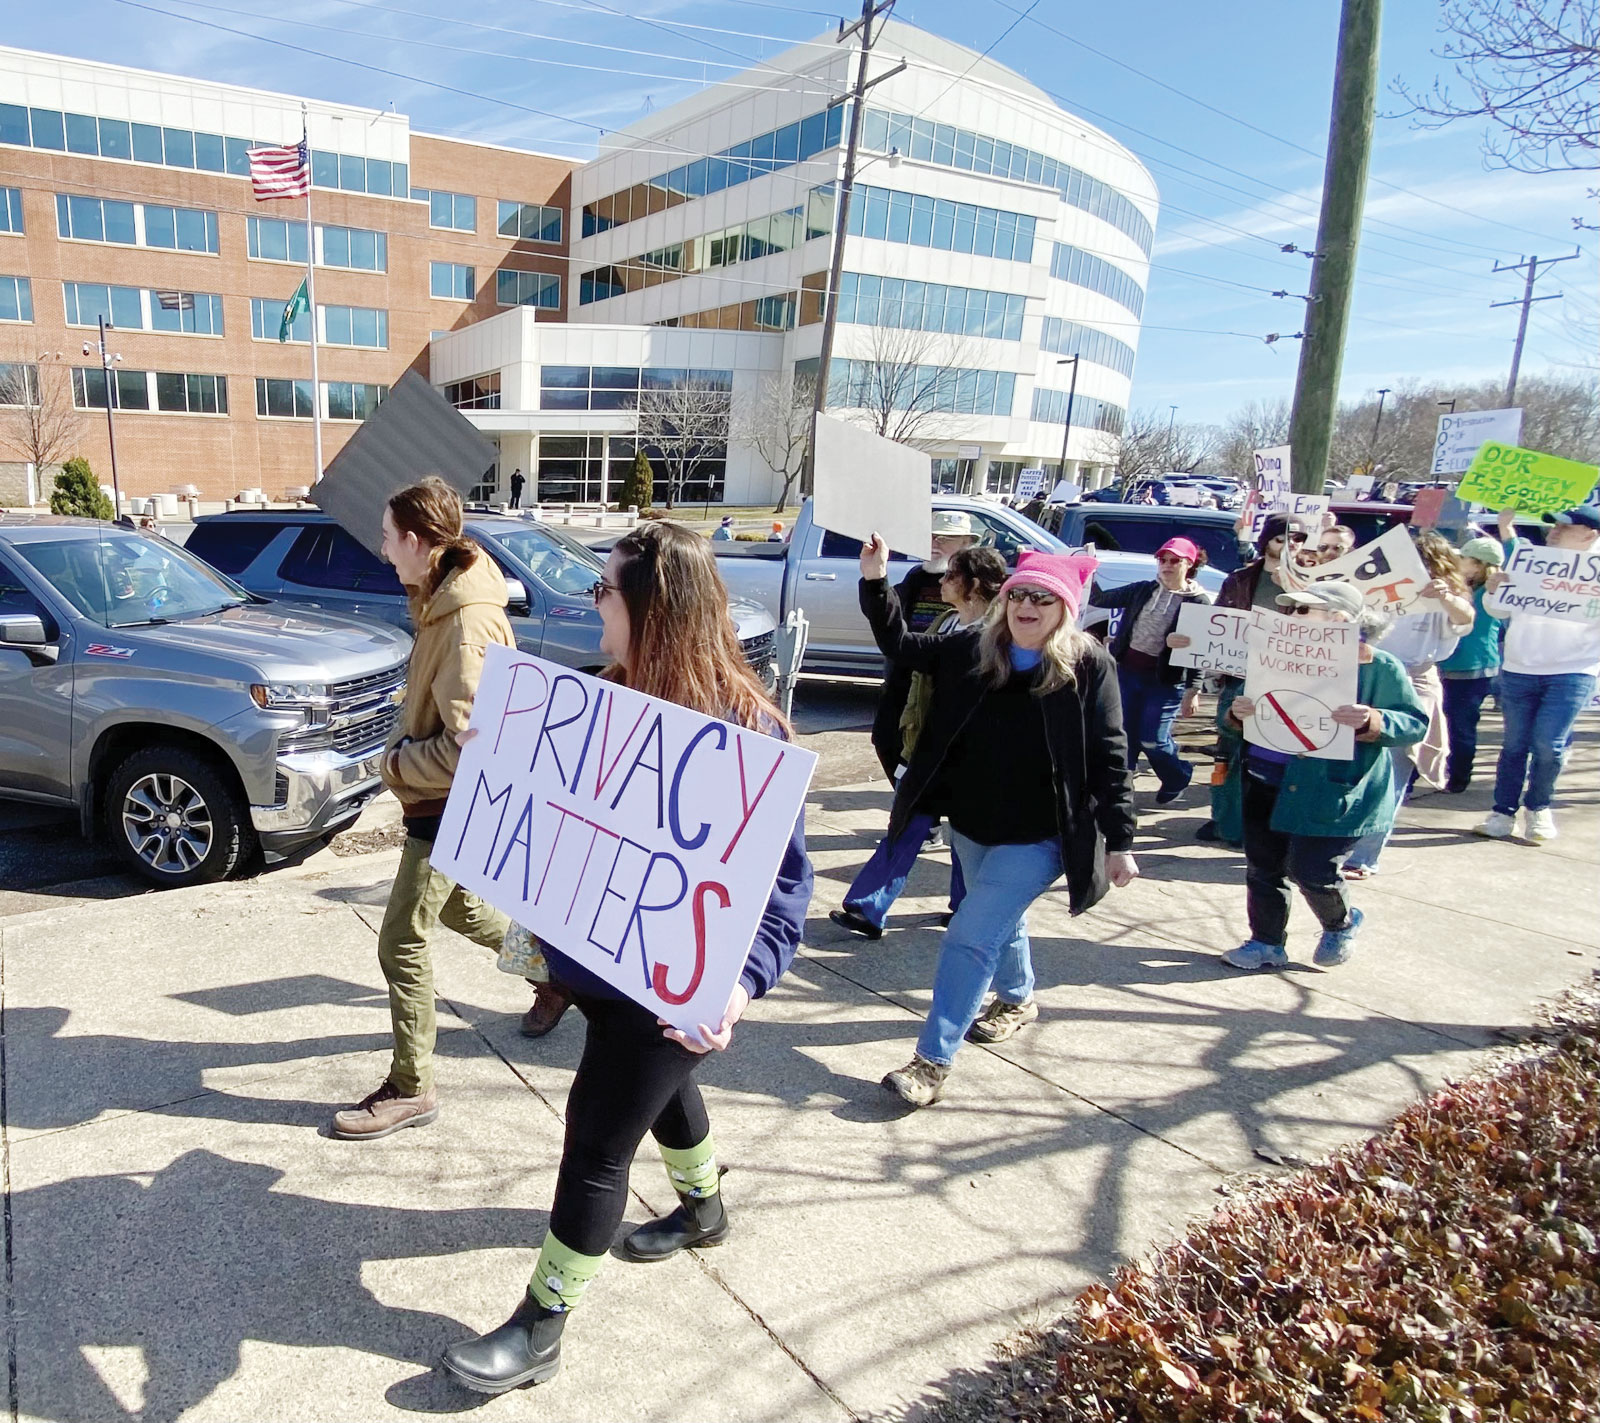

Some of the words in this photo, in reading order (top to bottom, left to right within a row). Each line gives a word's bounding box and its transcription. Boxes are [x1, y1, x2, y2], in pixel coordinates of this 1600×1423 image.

[1483, 446, 1539, 474] OUR
[1257, 473, 1274, 492] Our
[1466, 472, 1502, 492] IS
[1504, 484, 1560, 505] GOING
[1512, 548, 1580, 580] Fiscal
[1499, 584, 1582, 615] Taxpayer
[1540, 578, 1600, 597] SAVES
[1252, 609, 1266, 631] I
[1271, 618, 1350, 645] SUPPORT
[1267, 636, 1339, 662] FEDERAL
[1259, 652, 1339, 678] WORKERS
[494, 662, 785, 864] PRIVACY
[454, 769, 732, 1006] MATTERS
